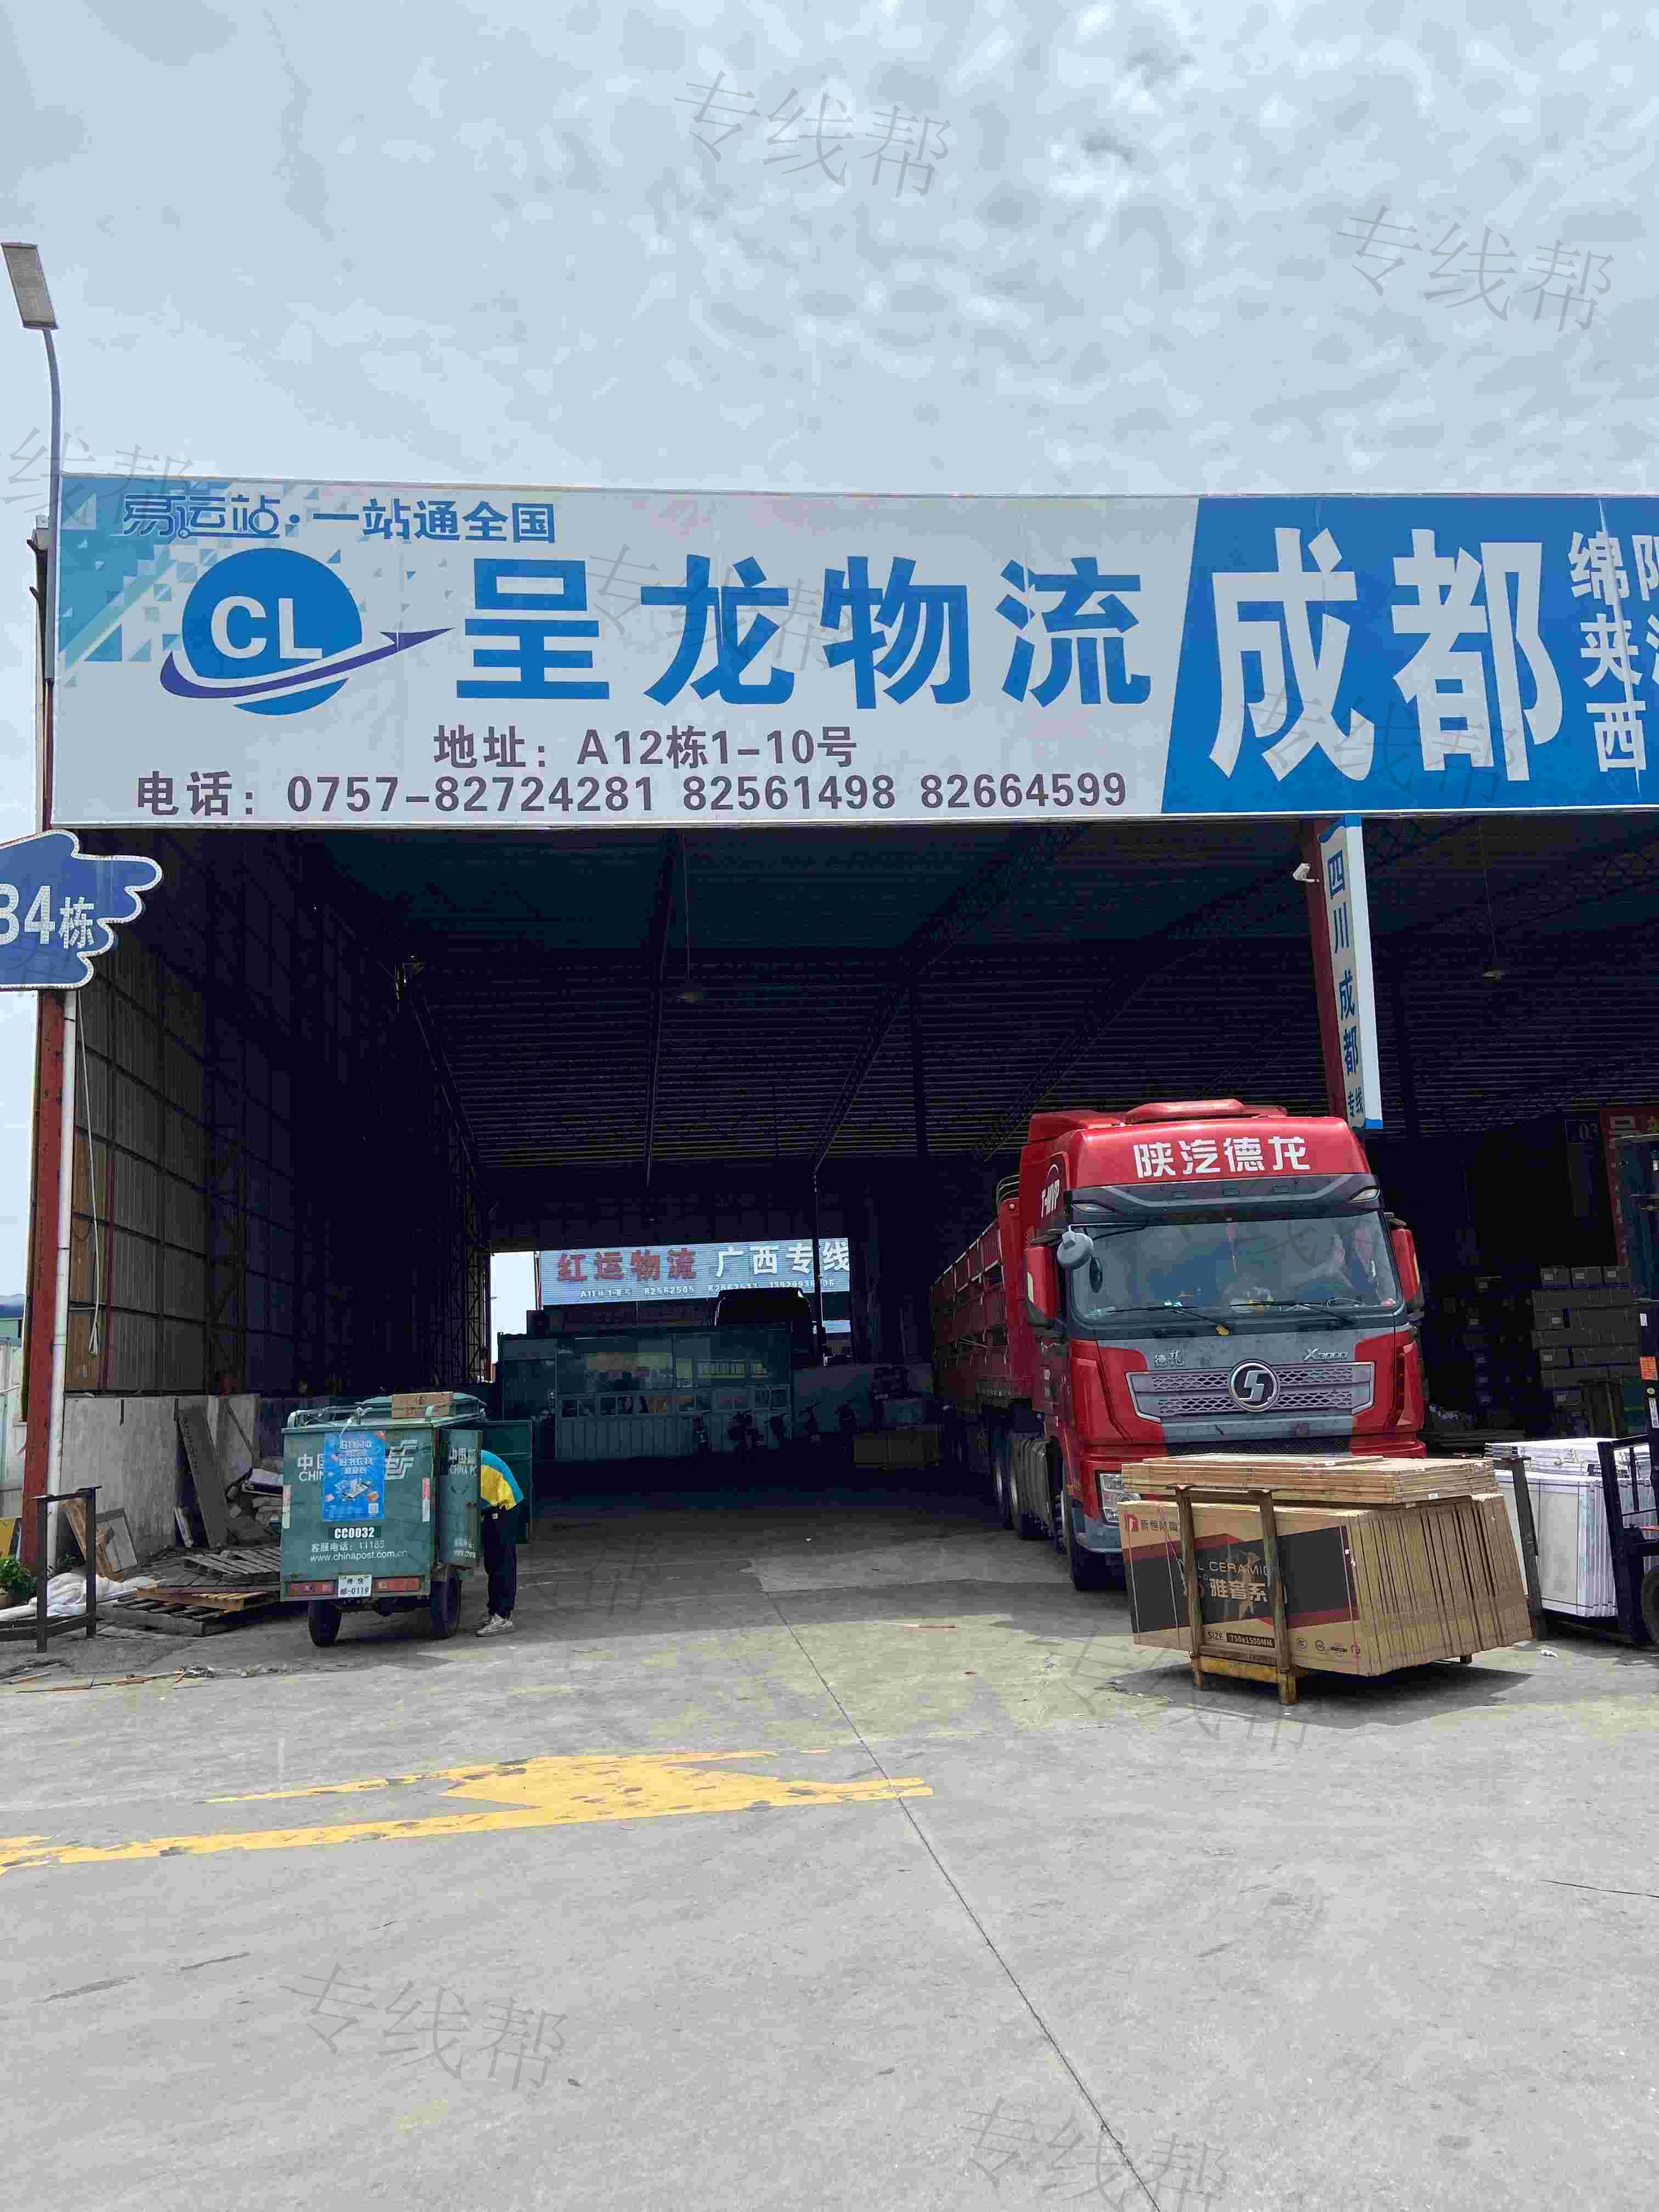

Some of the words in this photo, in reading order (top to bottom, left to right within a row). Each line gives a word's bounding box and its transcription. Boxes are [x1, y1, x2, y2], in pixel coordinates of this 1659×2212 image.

[210, 595, 324, 660] CL
[456, 554, 1152, 709] 呈龙物流
[1209, 527, 1563, 782] 成都
[1580, 613, 1659, 687] 夹
[286, 776, 653, 813] 0757-82724281
[682, 774, 895, 811] 82561498
[920, 772, 1126, 808] 82664599
[1132, 1136, 1311, 1178] 陕汽德龙
[557, 1247, 697, 1282] 红运物流
[715, 1241, 850, 1278] 广西专线
[334, 1527, 375, 1539] CC0032
[1207, 1632, 1225, 1640] SIZE
